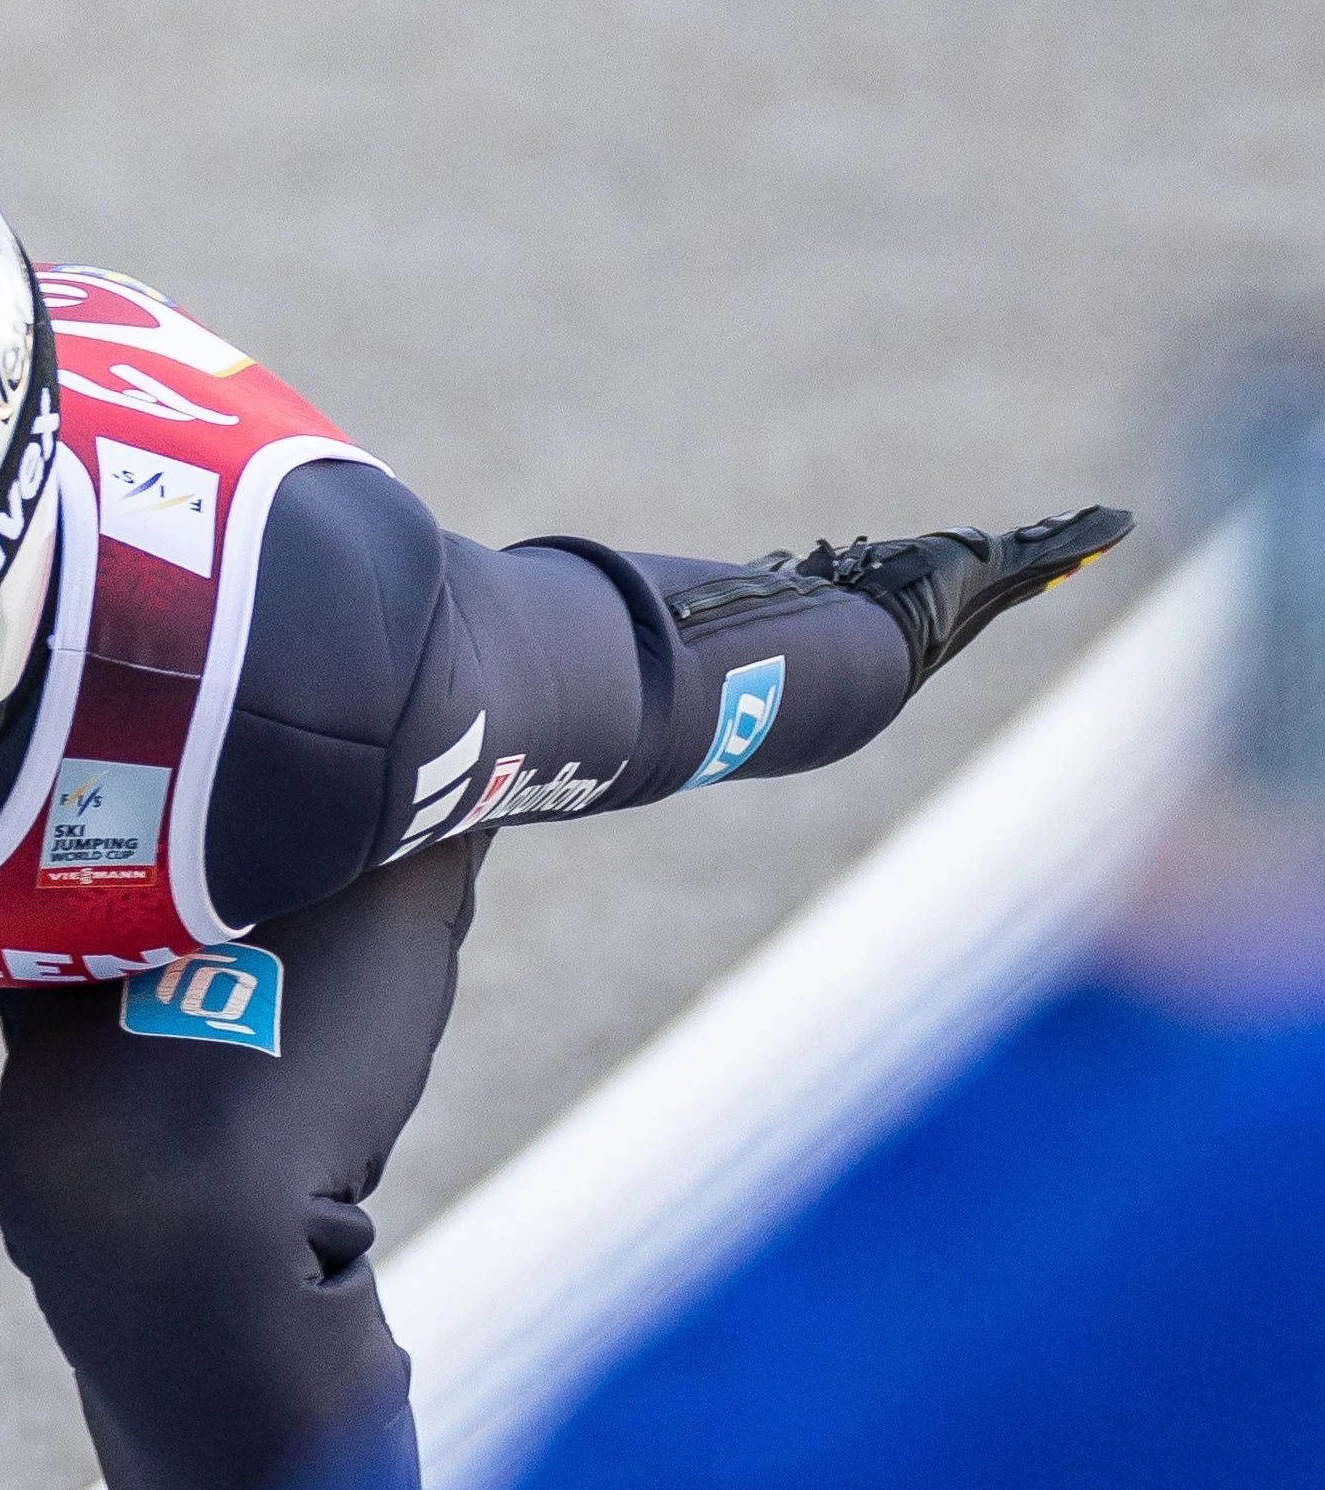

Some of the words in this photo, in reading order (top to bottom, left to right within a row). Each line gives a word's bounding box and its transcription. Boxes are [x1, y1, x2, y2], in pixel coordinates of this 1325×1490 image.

[54, 824, 86, 838] SKI
[51, 838, 138, 852] JUMPING
[50, 851, 102, 862] WORLD
[105, 850, 135, 860] CUP
